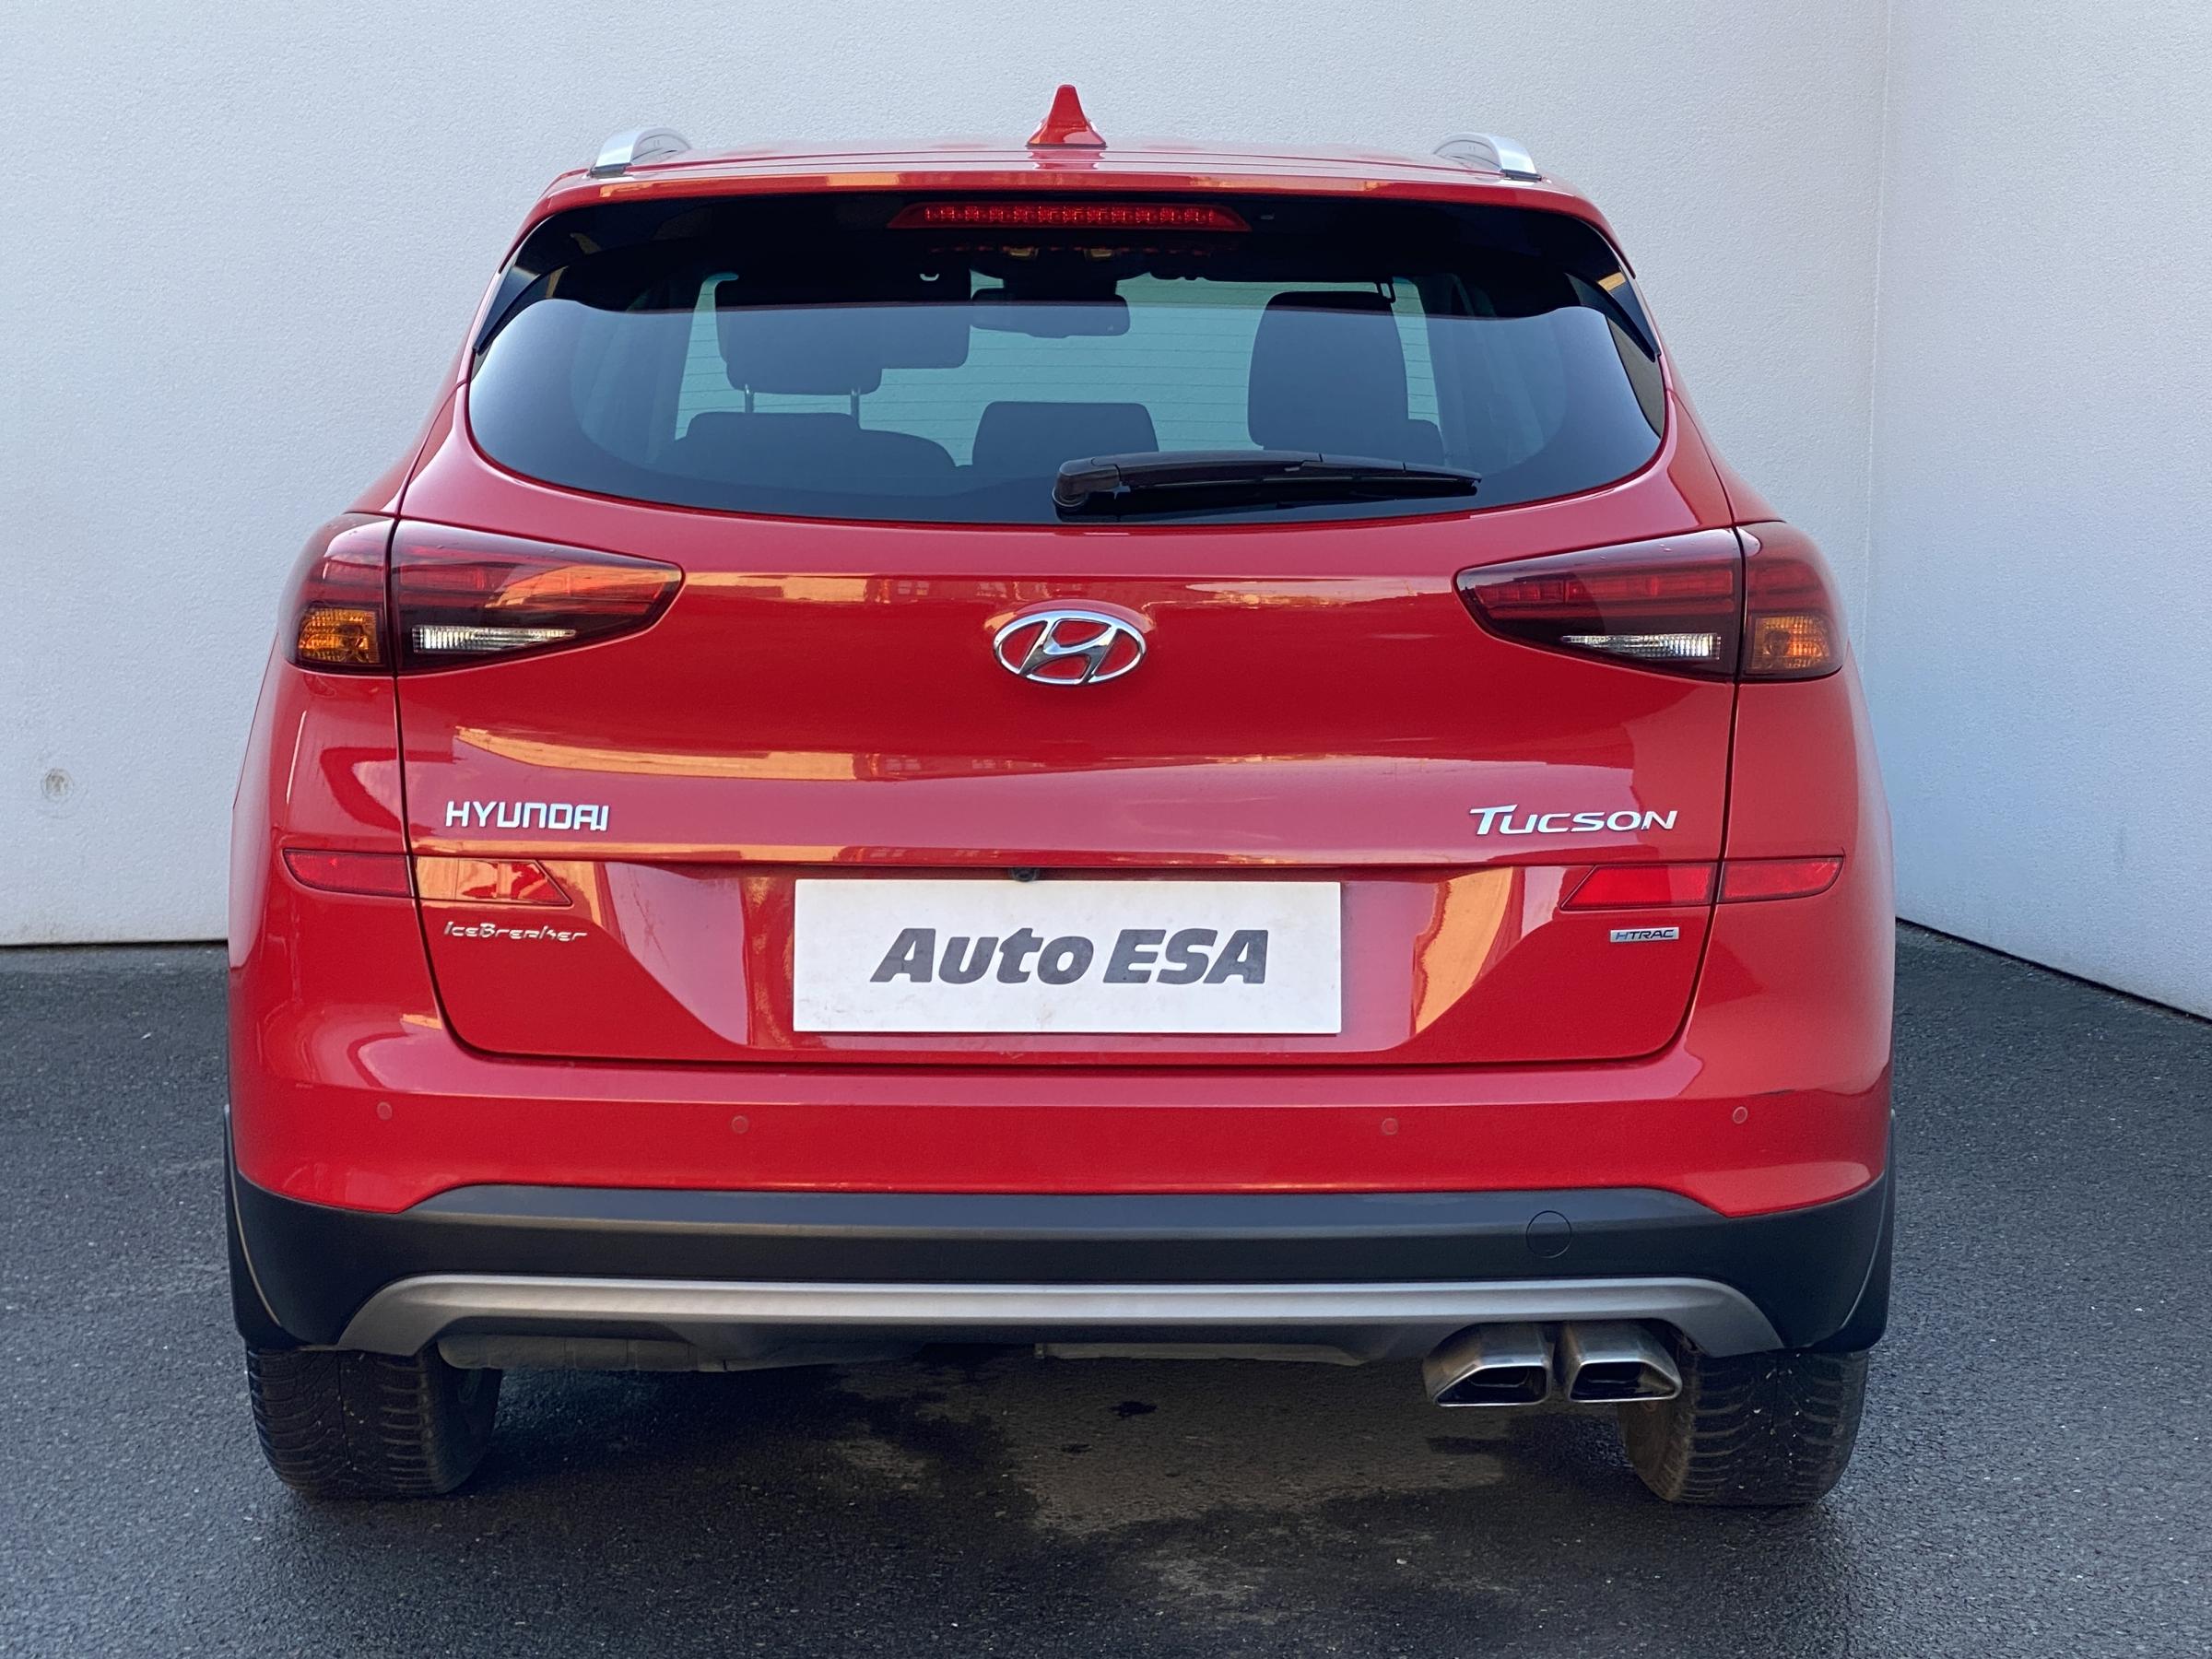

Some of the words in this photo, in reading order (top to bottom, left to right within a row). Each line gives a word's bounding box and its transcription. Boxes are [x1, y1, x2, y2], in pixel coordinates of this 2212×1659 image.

[445, 800, 609, 831] HYUNDAI
[1469, 804, 1678, 835] TUCSON
[443, 921, 588, 942] IceBreaker
[1615, 929, 1675, 940] HTRAC
[869, 927, 1094, 985] Auto
[1102, 928, 1269, 984] ESA
